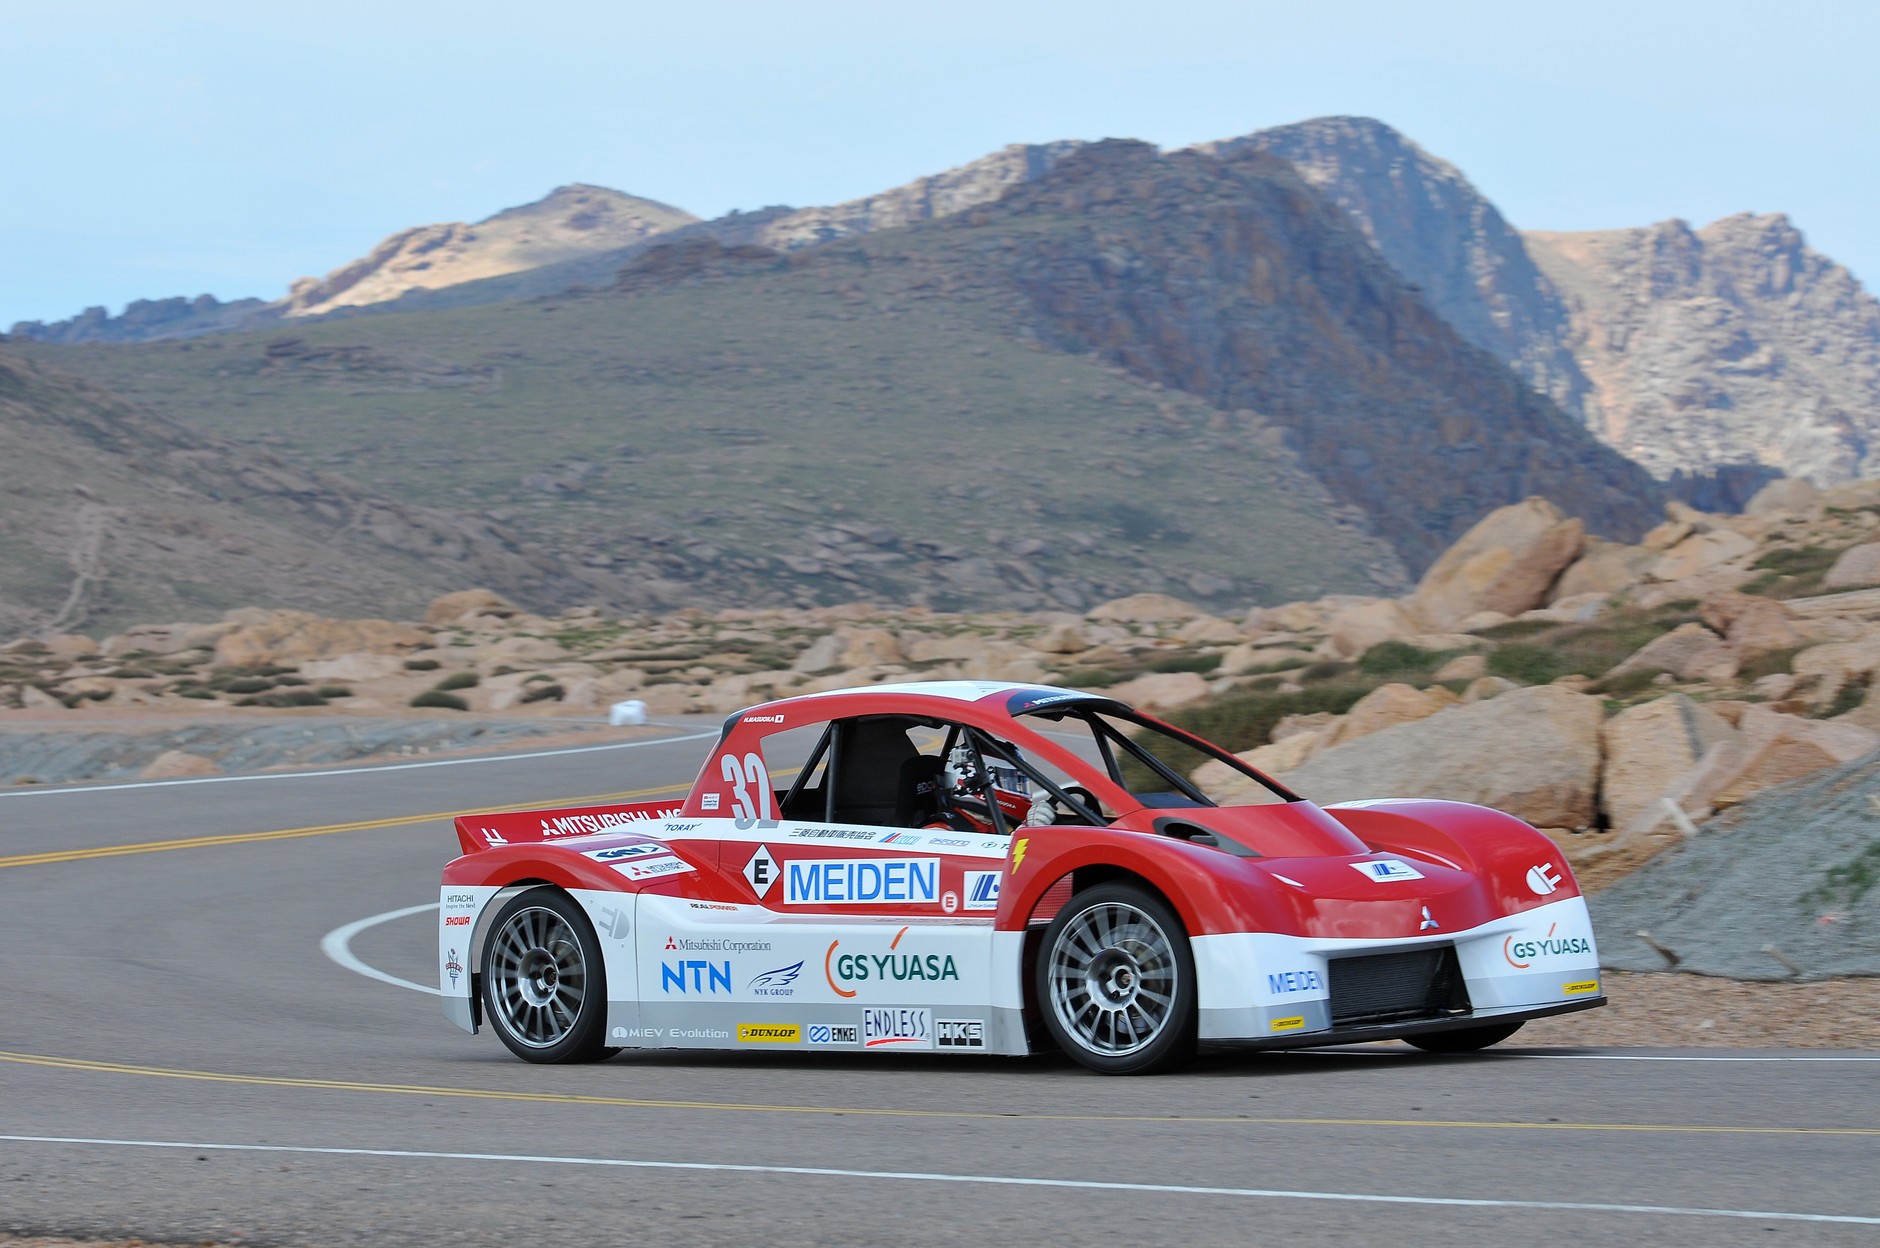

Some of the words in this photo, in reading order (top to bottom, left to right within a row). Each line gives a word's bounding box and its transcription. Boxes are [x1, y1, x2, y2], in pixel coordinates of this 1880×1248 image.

[721, 752, 780, 831] 32
[754, 859, 769, 884] E
[790, 862, 935, 901] MEIDEN
[447, 894, 474, 903] HITACHI
[946, 896, 954, 908] E
[445, 916, 471, 926] SHOWA
[679, 939, 721, 951] Mitsubishi
[723, 938, 771, 954] Corporation
[1536, 938, 1591, 956] YUASA
[872, 954, 960, 981] YUASA
[661, 960, 732, 994] NTN
[1268, 970, 1325, 994] MEIDEN
[754, 988, 769, 996] NYK
[770, 988, 794, 996] GROUP
[864, 1009, 926, 1038] ENDLESS
[669, 1028, 729, 1039] Evolution
[750, 1028, 796, 1038] DUNLOP
[831, 1027, 857, 1042] ENKEI
[937, 1021, 984, 1047] HKS
